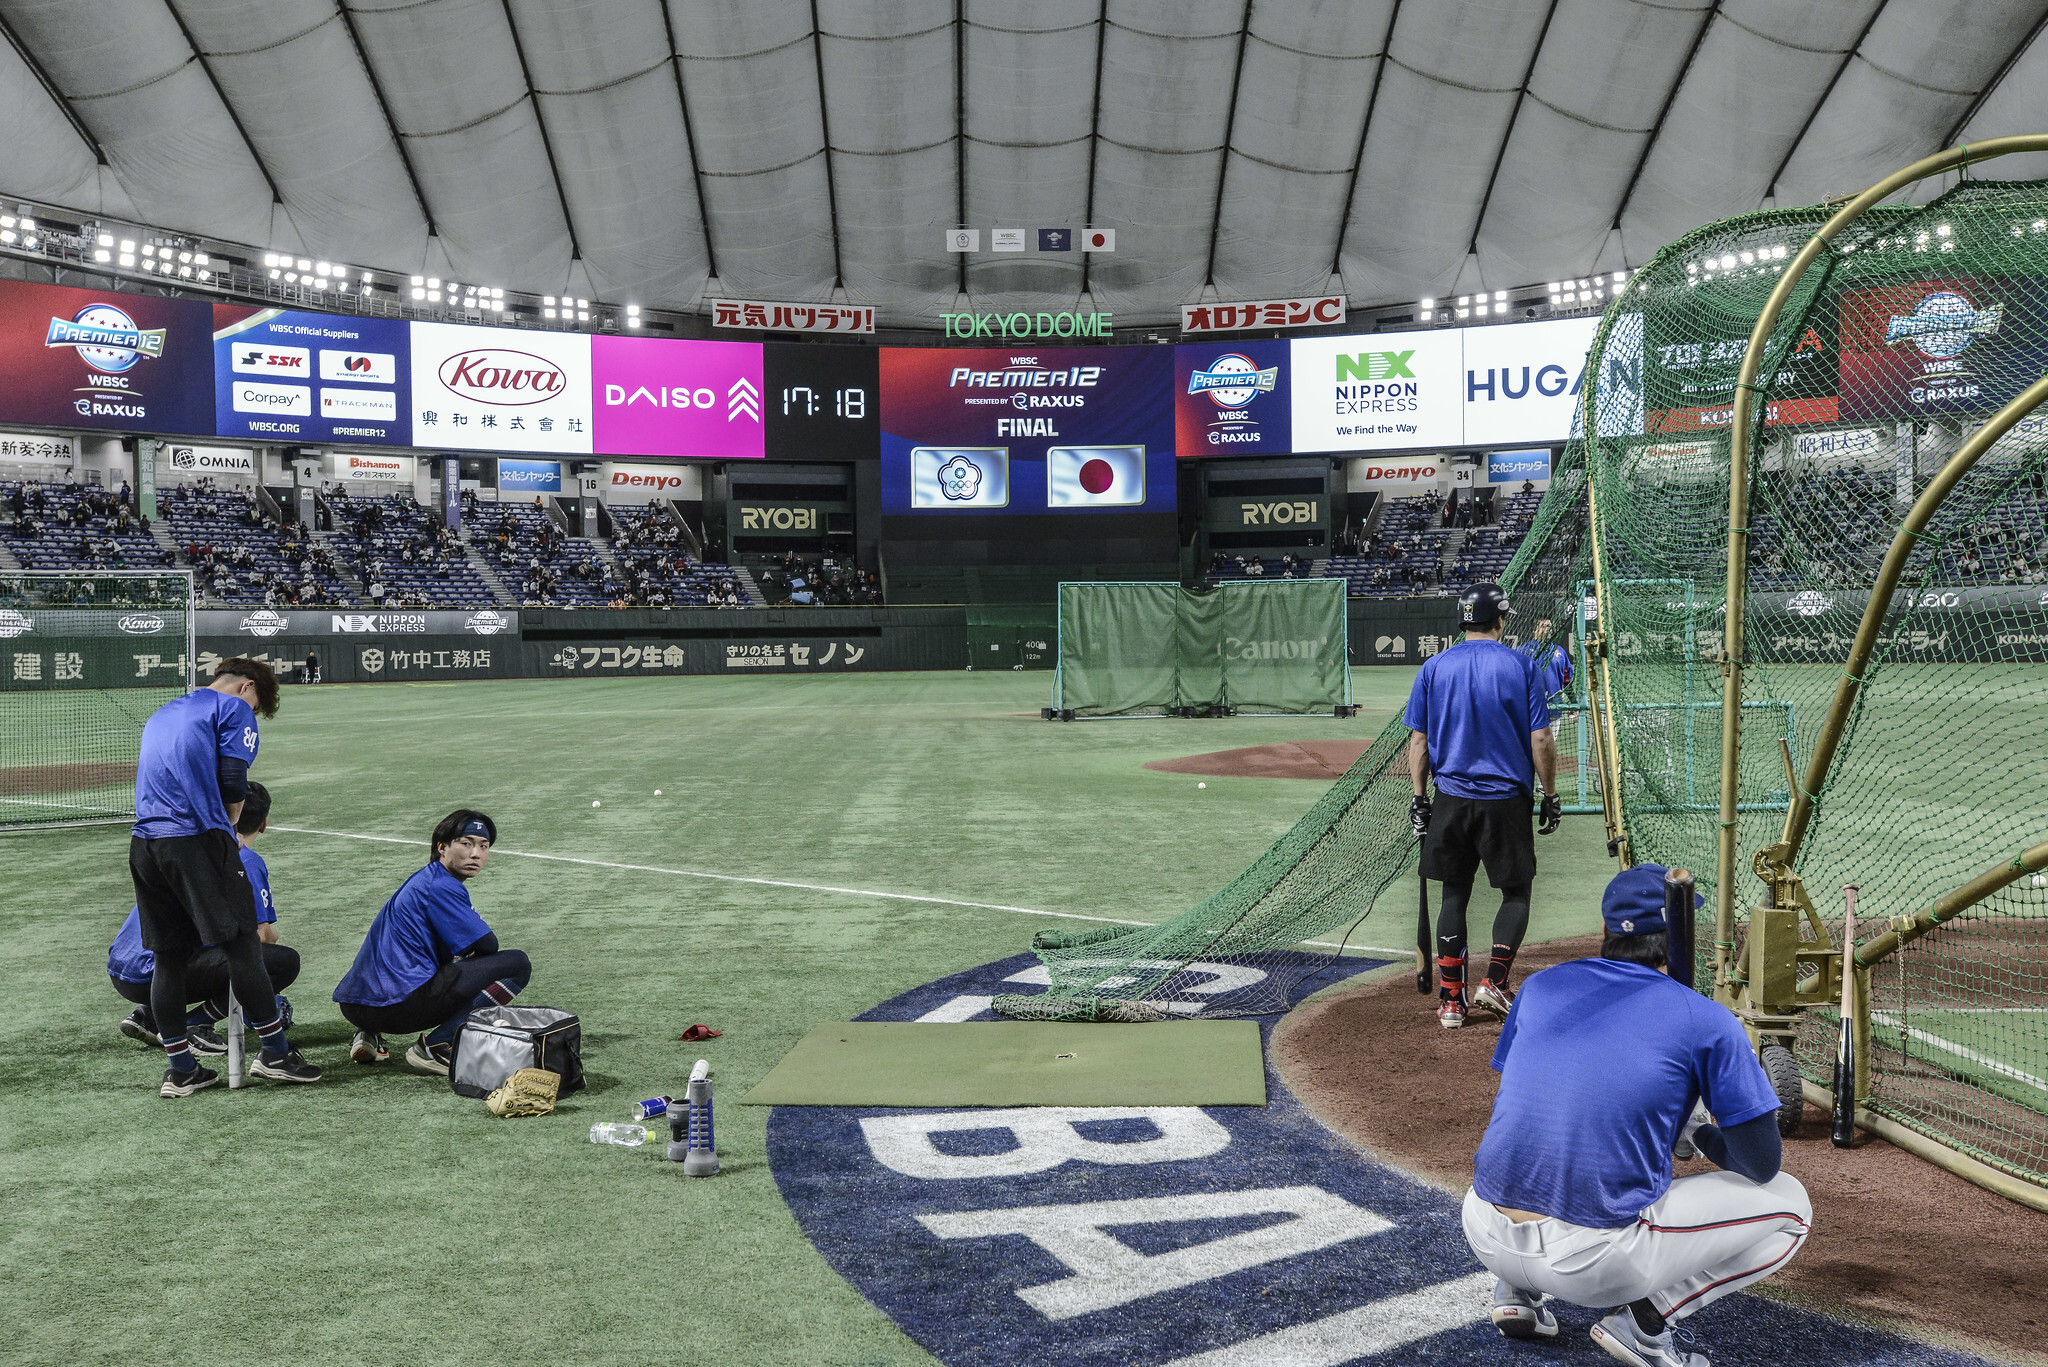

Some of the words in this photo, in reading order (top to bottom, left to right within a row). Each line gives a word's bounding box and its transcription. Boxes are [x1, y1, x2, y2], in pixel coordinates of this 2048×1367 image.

[715, 303, 872, 332] 元気ハツラツ!
[1187, 298, 1342, 331] オロナミンC
[269, 323, 294, 334] WBSC
[294, 327, 322, 336] Official
[323, 329, 359, 339] Suppliers
[939, 314, 1031, 337] TOKYO
[1036, 313, 1113, 337] DOME
[51, 322, 138, 347] PREMIER
[141, 334, 162, 351] 12
[266, 355, 303, 367] SSK
[1010, 357, 1038, 365] WBSC
[88, 374, 129, 388] WBSC
[449, 356, 562, 392] Kowa
[1193, 375, 1256, 388] PREMIER
[1258, 373, 1275, 386] 12
[605, 384, 716, 409] DAISO
[1336, 382, 1417, 400] NIPPON
[1927, 385, 1980, 401] RAXUS
[335, 400, 393, 409] TRACKMAN
[964, 397, 999, 405] PRESENTED
[1000, 397, 1008, 405] BY
[1029, 394, 1085, 408] RAXUS
[1336, 398, 1418, 415] EXPRESS
[92, 403, 146, 418] RAXUS
[1218, 411, 1249, 421] WBSC
[249, 421, 300, 433] WBSC.ORG
[332, 427, 386, 437] #PREMIER12
[997, 418, 1060, 437] FINAL
[1336, 427, 1352, 436] We
[1355, 425, 1374, 435] Find
[1378, 425, 1393, 434] the
[1396, 423, 1418, 436] Way
[1221, 432, 1261, 443] RAXUS
[1, 440, 71, 459] 新菱冷熱
[200, 456, 250, 469] OMNIA
[350, 457, 400, 469] Bishamon
[1490, 460, 1549, 475] 文化シャッター
[304, 467, 312, 478] 4
[501, 470, 560, 483] 文化シャッター
[1366, 466, 1436, 482] Denyo
[1456, 470, 1470, 481] 34
[585, 479, 597, 490] 16
[611, 472, 682, 491] Denyo
[741, 507, 817, 530] RYOBI
[1241, 501, 1317, 525] RYOBI
[242, 617, 277, 627] PREMIER
[278, 618, 287, 626] 12
[379, 615, 425, 624] NIPPON
[467, 618, 498, 627] PREMIER
[1463, 612, 1474, 621] 83
[379, 624, 425, 632] EXPRESS
[726, 645, 786, 657] 守りの名手
[790, 643, 865, 665] セノン
[1217, 637, 1319, 660] Canon
[390, 649, 491, 669] 竹中工務店
[581, 645, 684, 668] フコク生命
[743, 657, 769, 666] SENON
[243, 726, 258, 753] 84
[260, 888, 274, 908] 8
